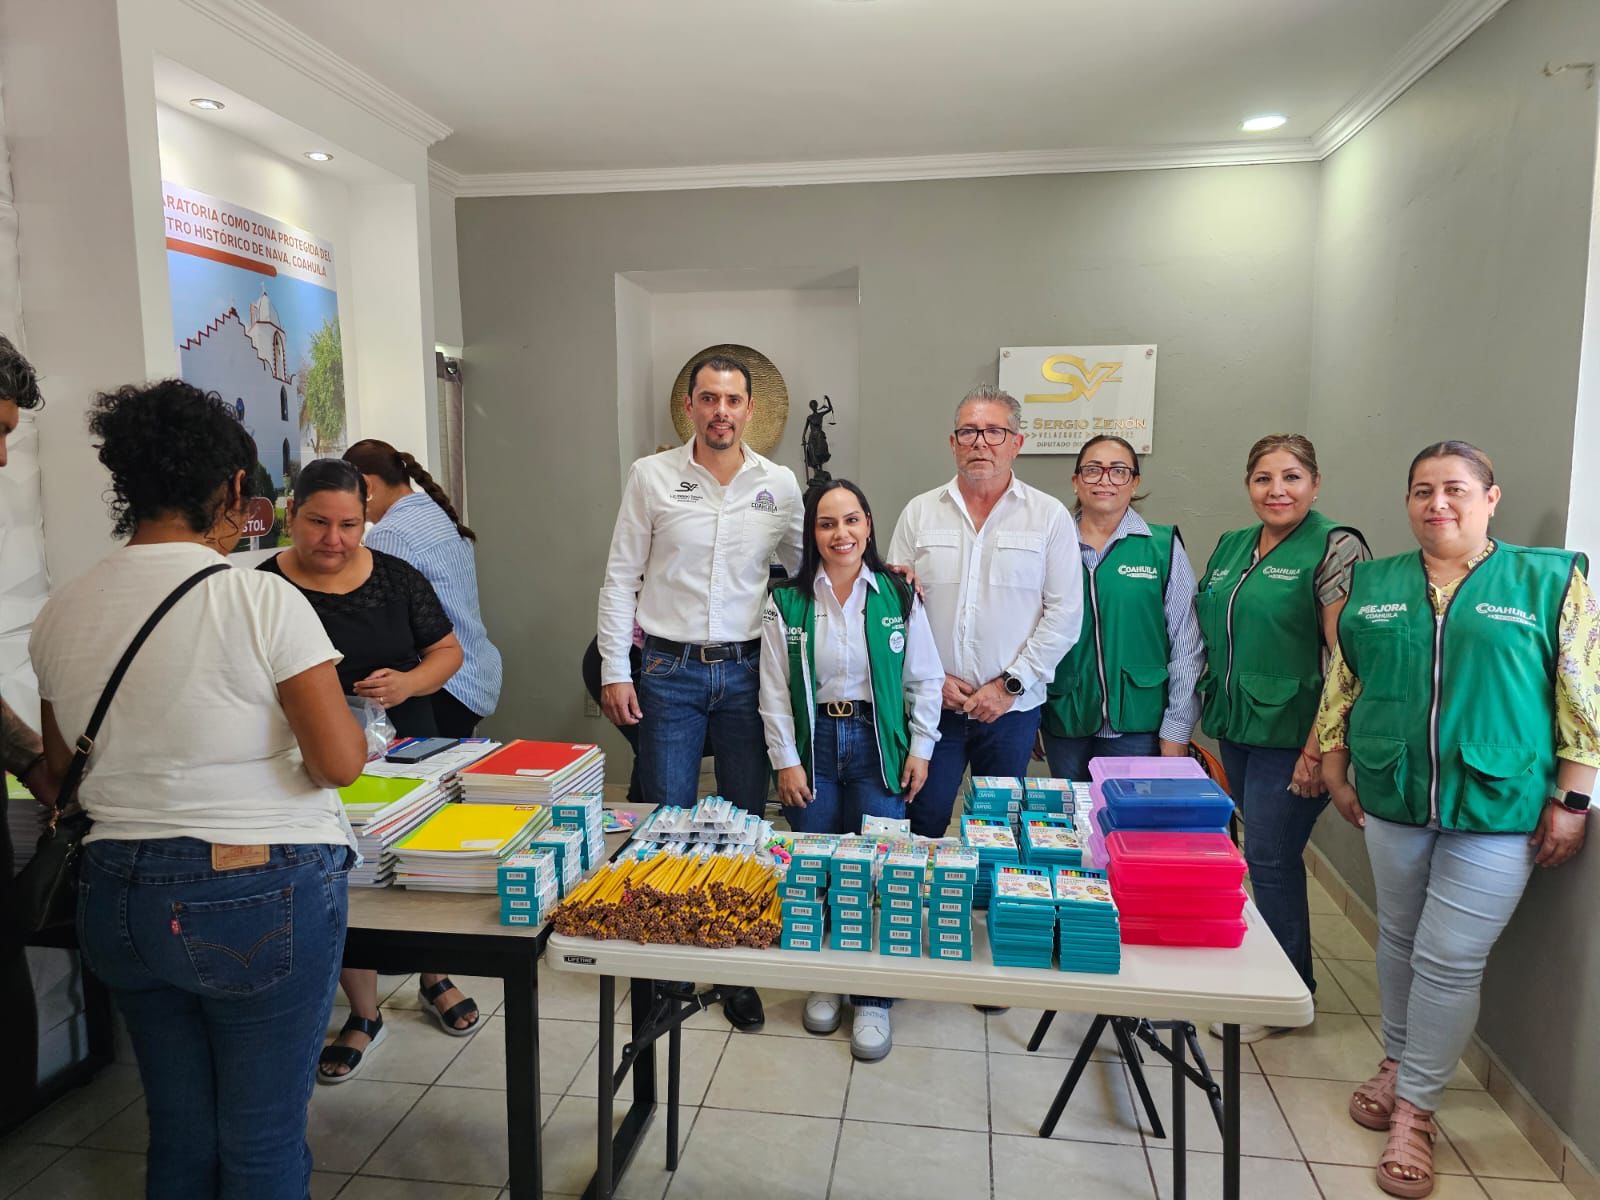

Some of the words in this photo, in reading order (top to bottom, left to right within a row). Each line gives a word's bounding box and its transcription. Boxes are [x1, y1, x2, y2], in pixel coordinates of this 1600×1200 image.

[221, 212, 250, 232] COMO
[252, 222, 277, 241] ZONA
[278, 232, 321, 257] PROTEGIDA
[319, 248, 332, 262] DEL
[194, 224, 250, 251] HISTÓRICO
[252, 241, 264, 256] DE
[292, 255, 327, 277] COAHUILA
[1033, 417, 1089, 430] SERGIO
[1092, 416, 1147, 430] ZENÓN
[1117, 564, 1158, 575] COAHUILA
[1357, 603, 1408, 615] MEJORA
[1475, 602, 1537, 621] COAHUILA
